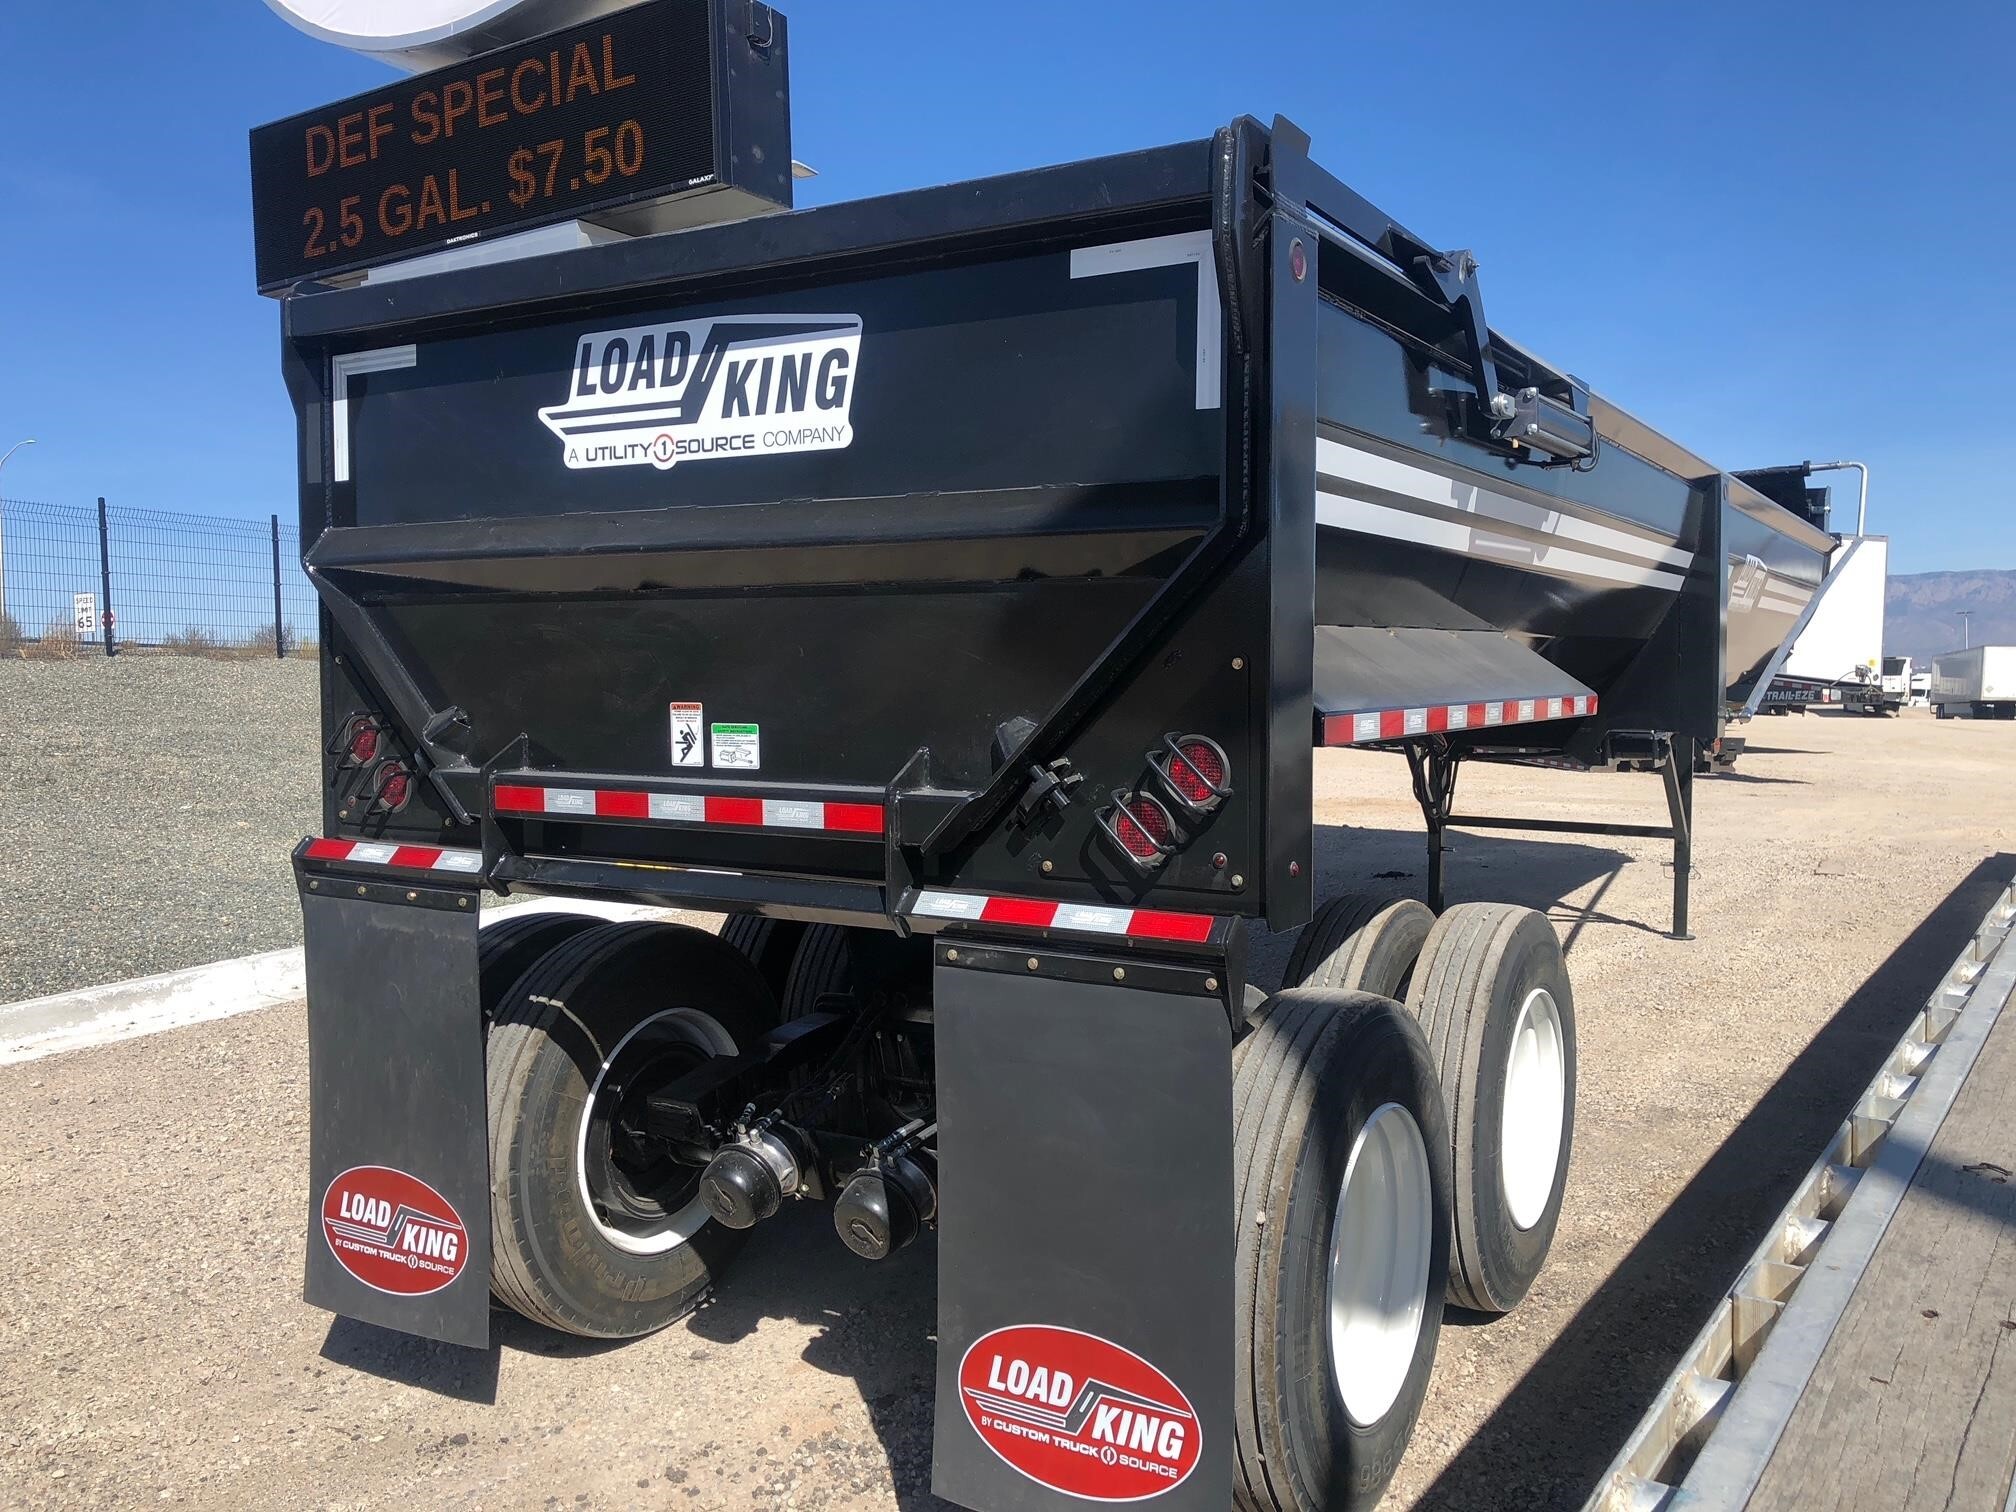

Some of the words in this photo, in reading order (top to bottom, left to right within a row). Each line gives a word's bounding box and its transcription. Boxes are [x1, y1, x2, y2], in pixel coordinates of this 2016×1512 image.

[305, 103, 395, 177] DEF
[411, 34, 637, 145] SPECIAL
[303, 196, 363, 258] 2.5
[378, 168, 492, 237] GAL.
[508, 119, 644, 208] $7.50
[576, 330, 692, 397] LOAD
[721, 348, 850, 419] KING
[568, 448, 579, 463] A
[585, 442, 653, 462] UTILITY
[675, 434, 755, 455] SOURCE
[763, 425, 845, 448] COMPANY
[76, 596, 94, 604] SPEED
[78, 616, 93, 629] 65
[340, 1191, 391, 1228] LOAD
[402, 1223, 458, 1262] KING
[342, 1238, 378, 1256] CUSTOM
[378, 1249, 407, 1264] TRUCK
[419, 1260, 455, 1275] SOURCE
[987, 1354, 1073, 1408] LOAD
[1091, 1403, 1185, 1461] KING
[981, 1416, 992, 1428] BY
[993, 1421, 1050, 1444] CUSTOM
[1052, 1435, 1099, 1458] TRUCK
[1119, 1454, 1178, 1478] SOURCE
